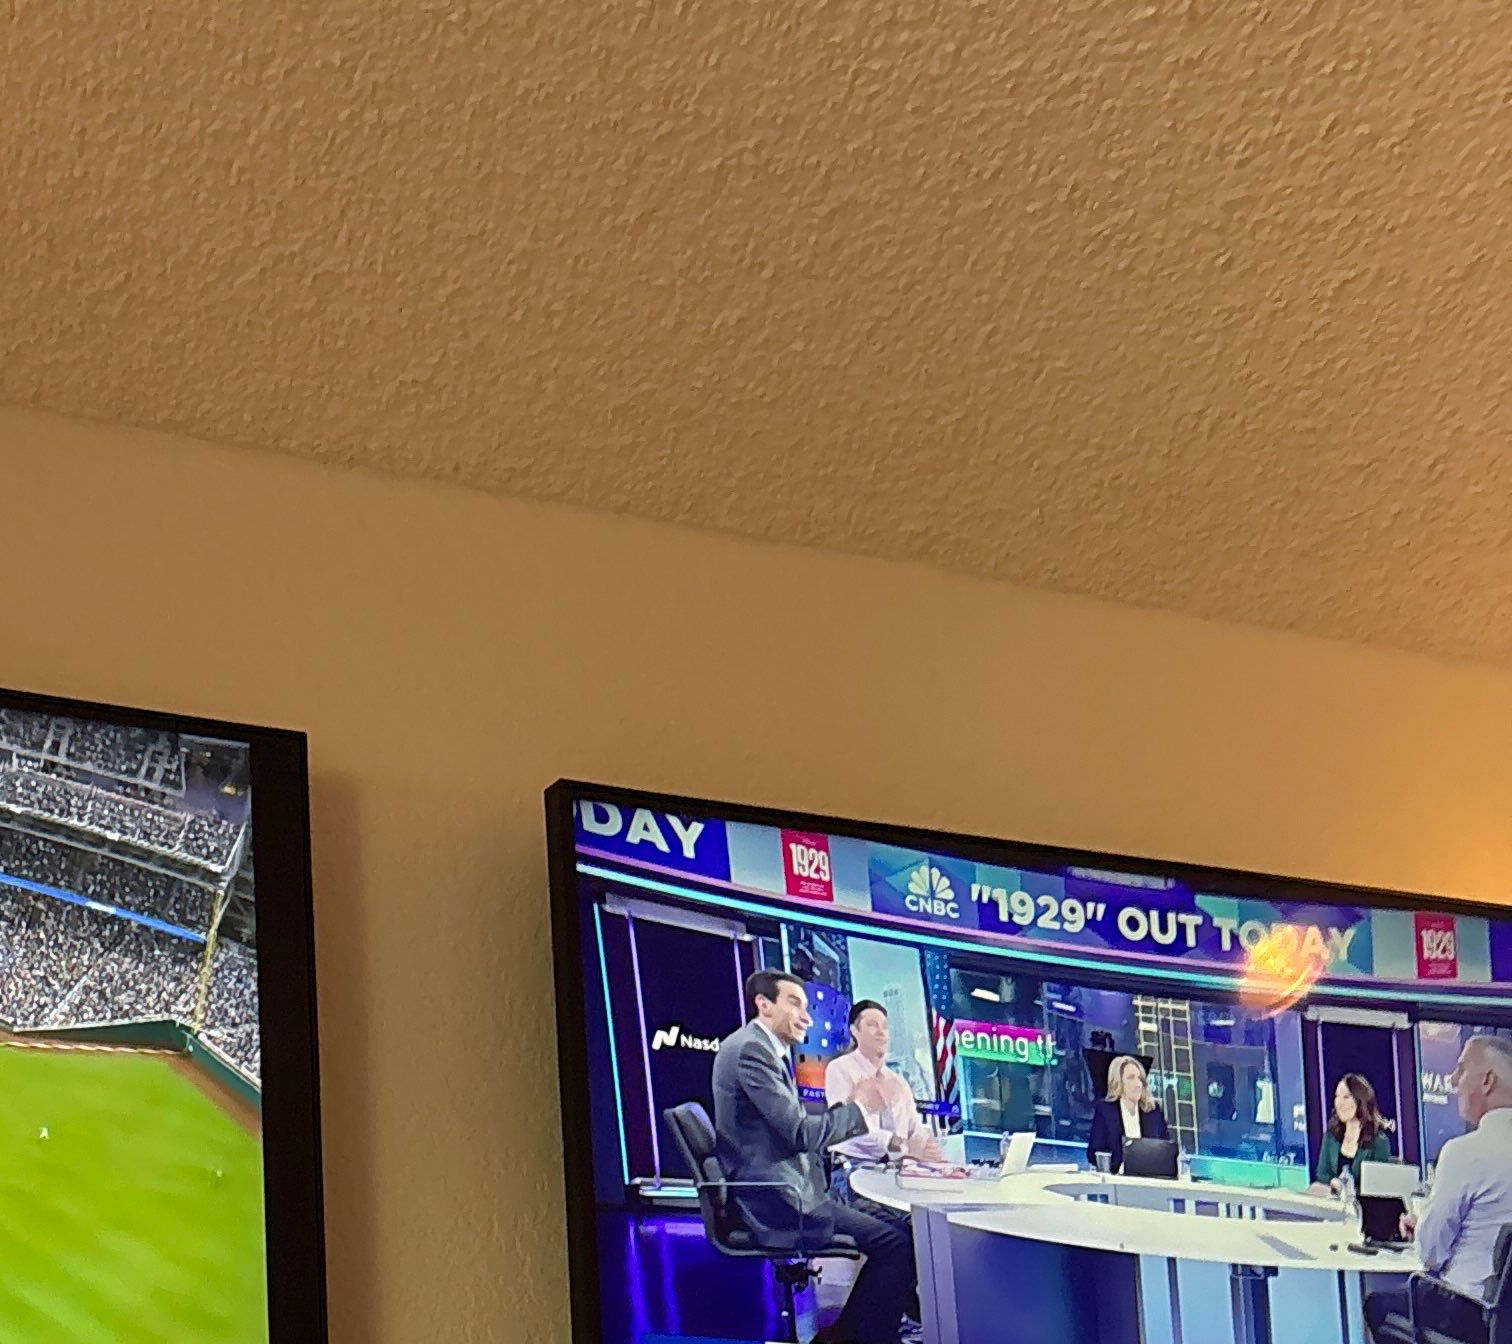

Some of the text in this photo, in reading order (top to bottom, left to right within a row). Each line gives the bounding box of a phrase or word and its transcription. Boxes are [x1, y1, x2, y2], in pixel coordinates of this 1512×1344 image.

[573, 800, 705, 859] DAY
[789, 842, 831, 883] 1929
[905, 894, 961, 920] CNBC
[971, 882, 1357, 961] "1929" OUT TODAY
